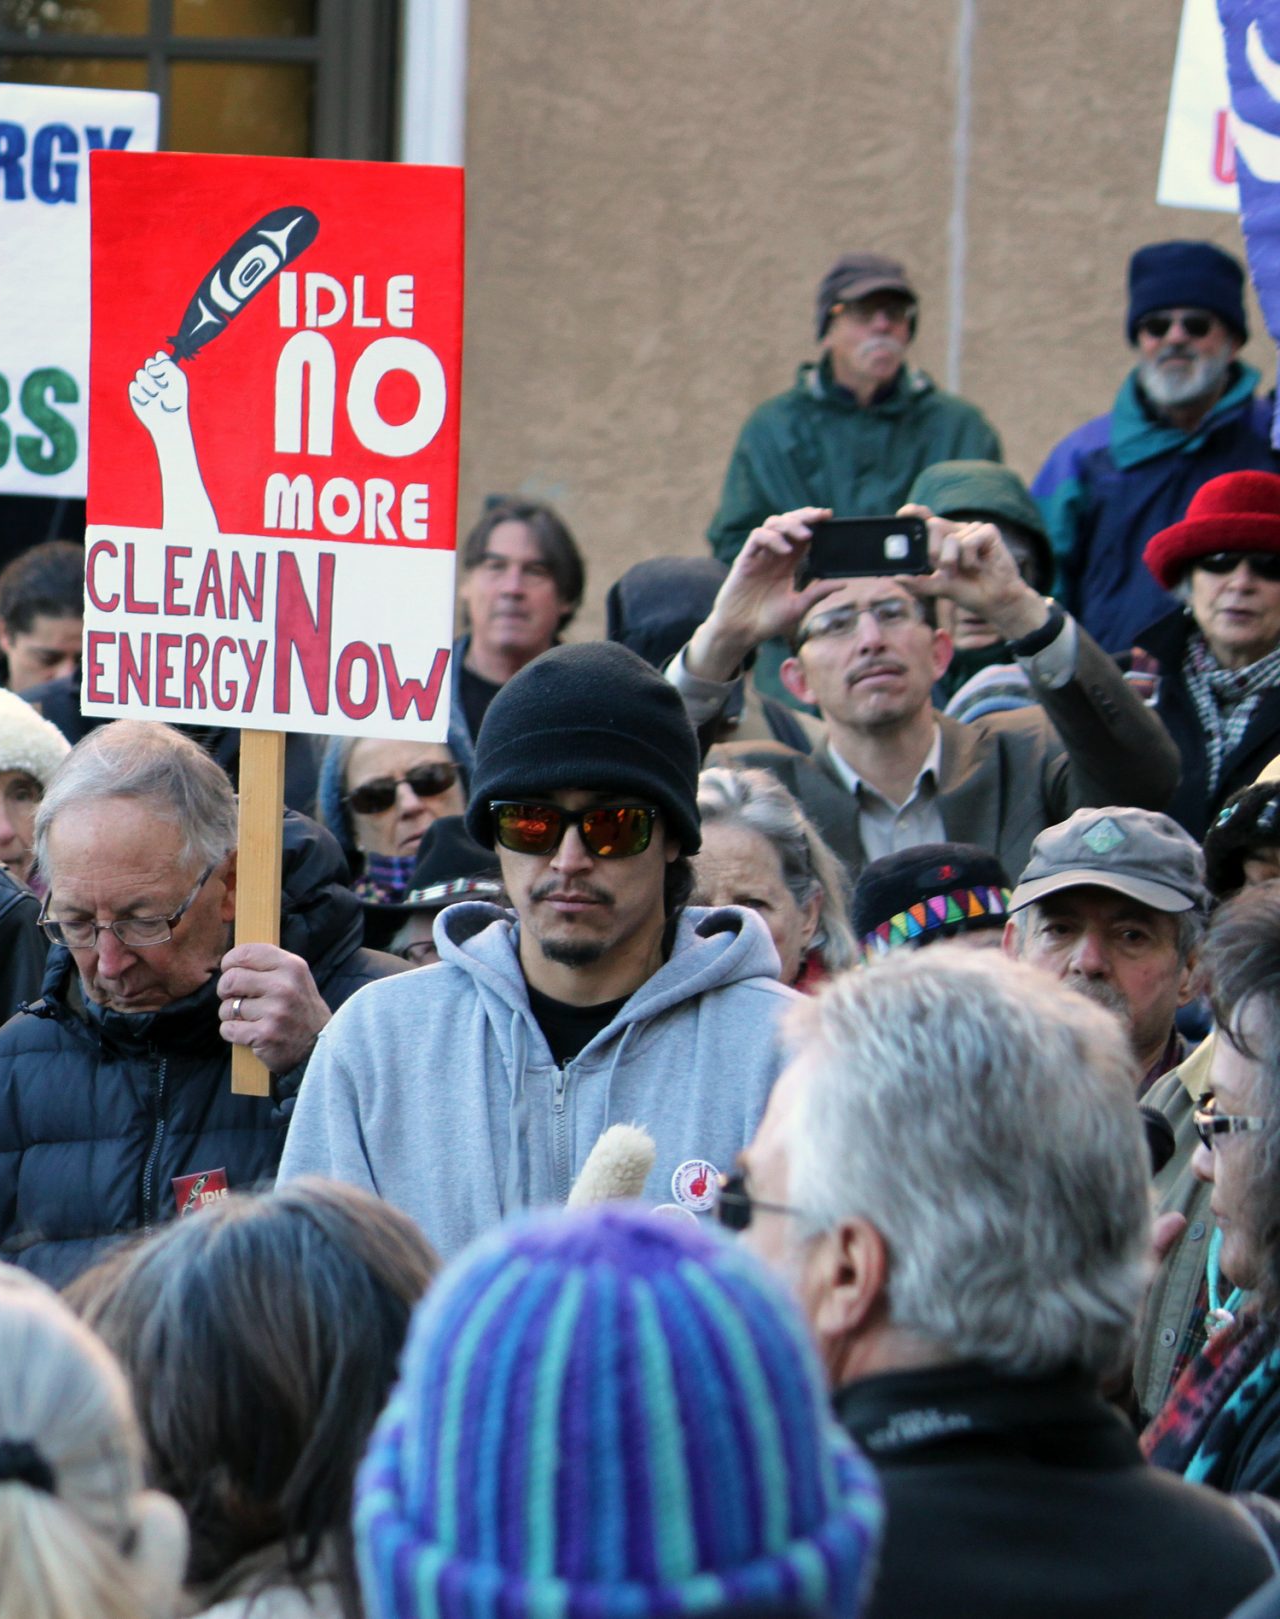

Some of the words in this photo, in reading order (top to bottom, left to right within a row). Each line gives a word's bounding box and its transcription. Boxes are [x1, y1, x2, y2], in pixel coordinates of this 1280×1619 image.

[278, 271, 414, 328] IDLE
[274, 329, 447, 457] NO
[263, 472, 429, 540] MORE
[85, 540, 266, 622] CLEAN
[86, 629, 267, 714] ENERGY
[273, 550, 451, 722] NOW
